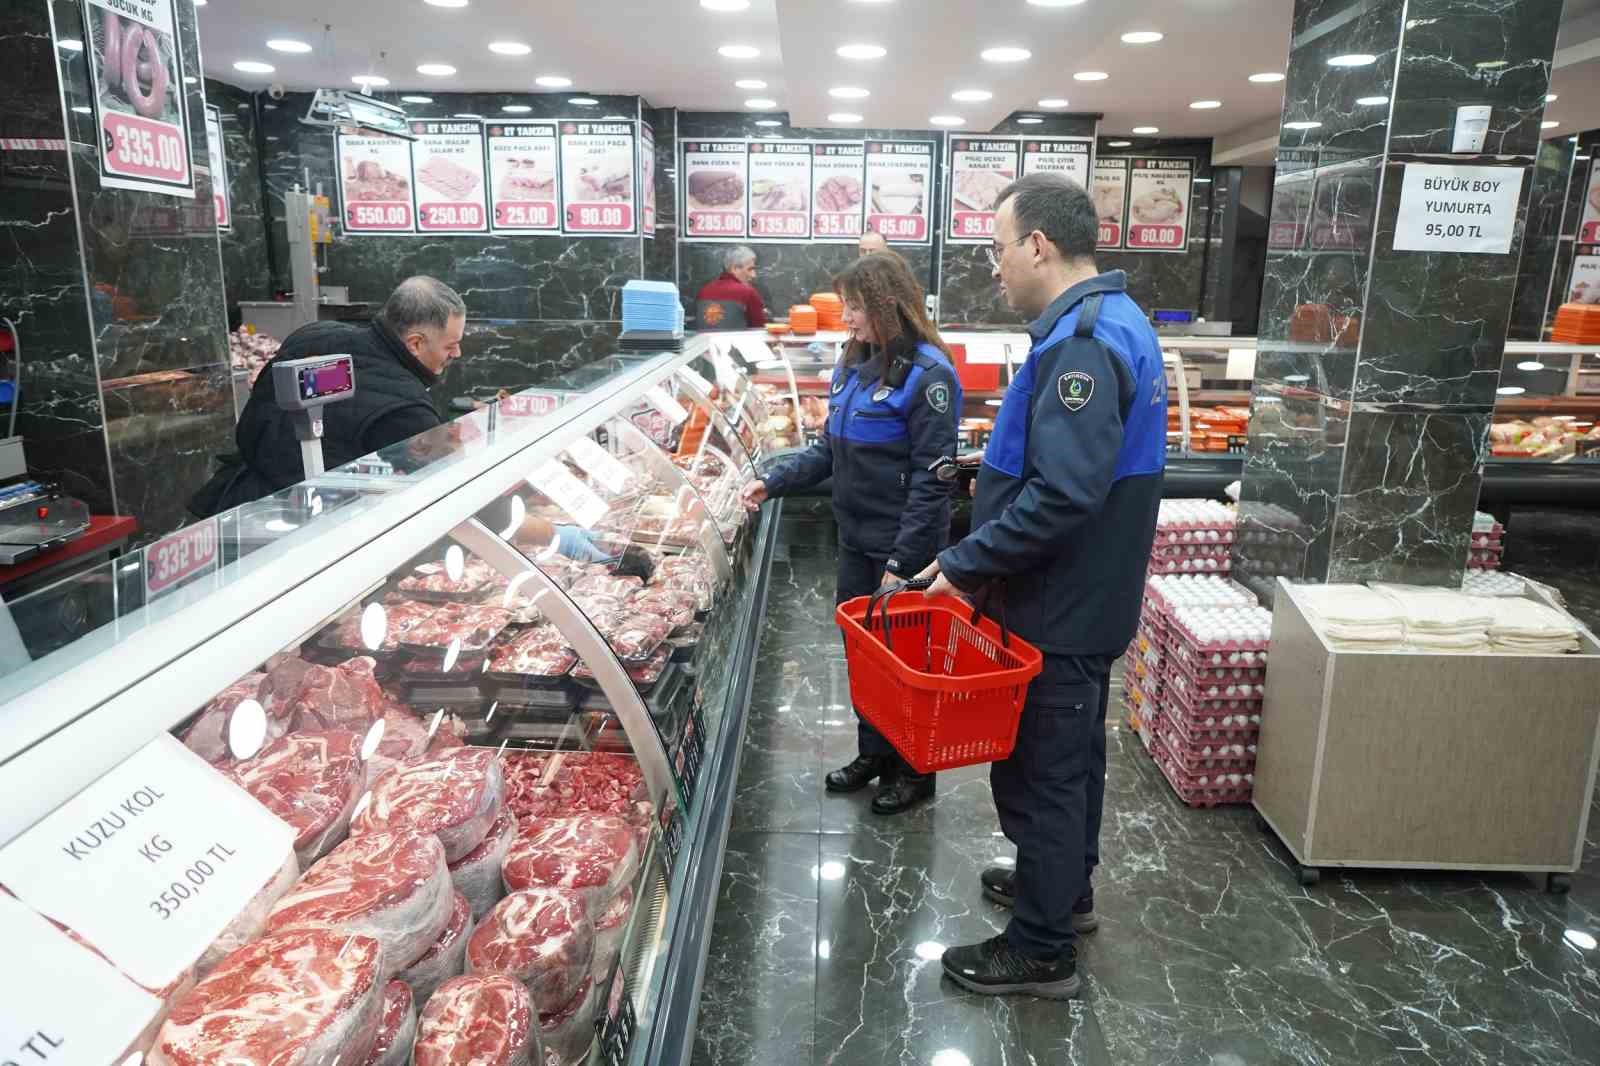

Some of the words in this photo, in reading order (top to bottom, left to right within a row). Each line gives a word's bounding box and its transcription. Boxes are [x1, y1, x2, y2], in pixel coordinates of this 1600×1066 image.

[116, 125, 183, 172] 335.00
[1424, 175, 1469, 192] BÜYÜK
[1473, 181, 1500, 193] BOY
[357, 207, 406, 225] 550.00
[429, 207, 478, 225] 250.00
[507, 206, 548, 224] 25.00
[580, 208, 622, 225] 90.00
[1425, 201, 1492, 215] YUMURTA
[1424, 224, 1464, 238] 95,00
[1468, 225, 1482, 238] TL
[63, 810, 126, 861] KUZU
[121, 785, 165, 818] KOL
[138, 834, 173, 863] KG
[150, 859, 215, 920] 350,00
[207, 842, 236, 866] TL
[19, 1031, 64, 1060] TL
